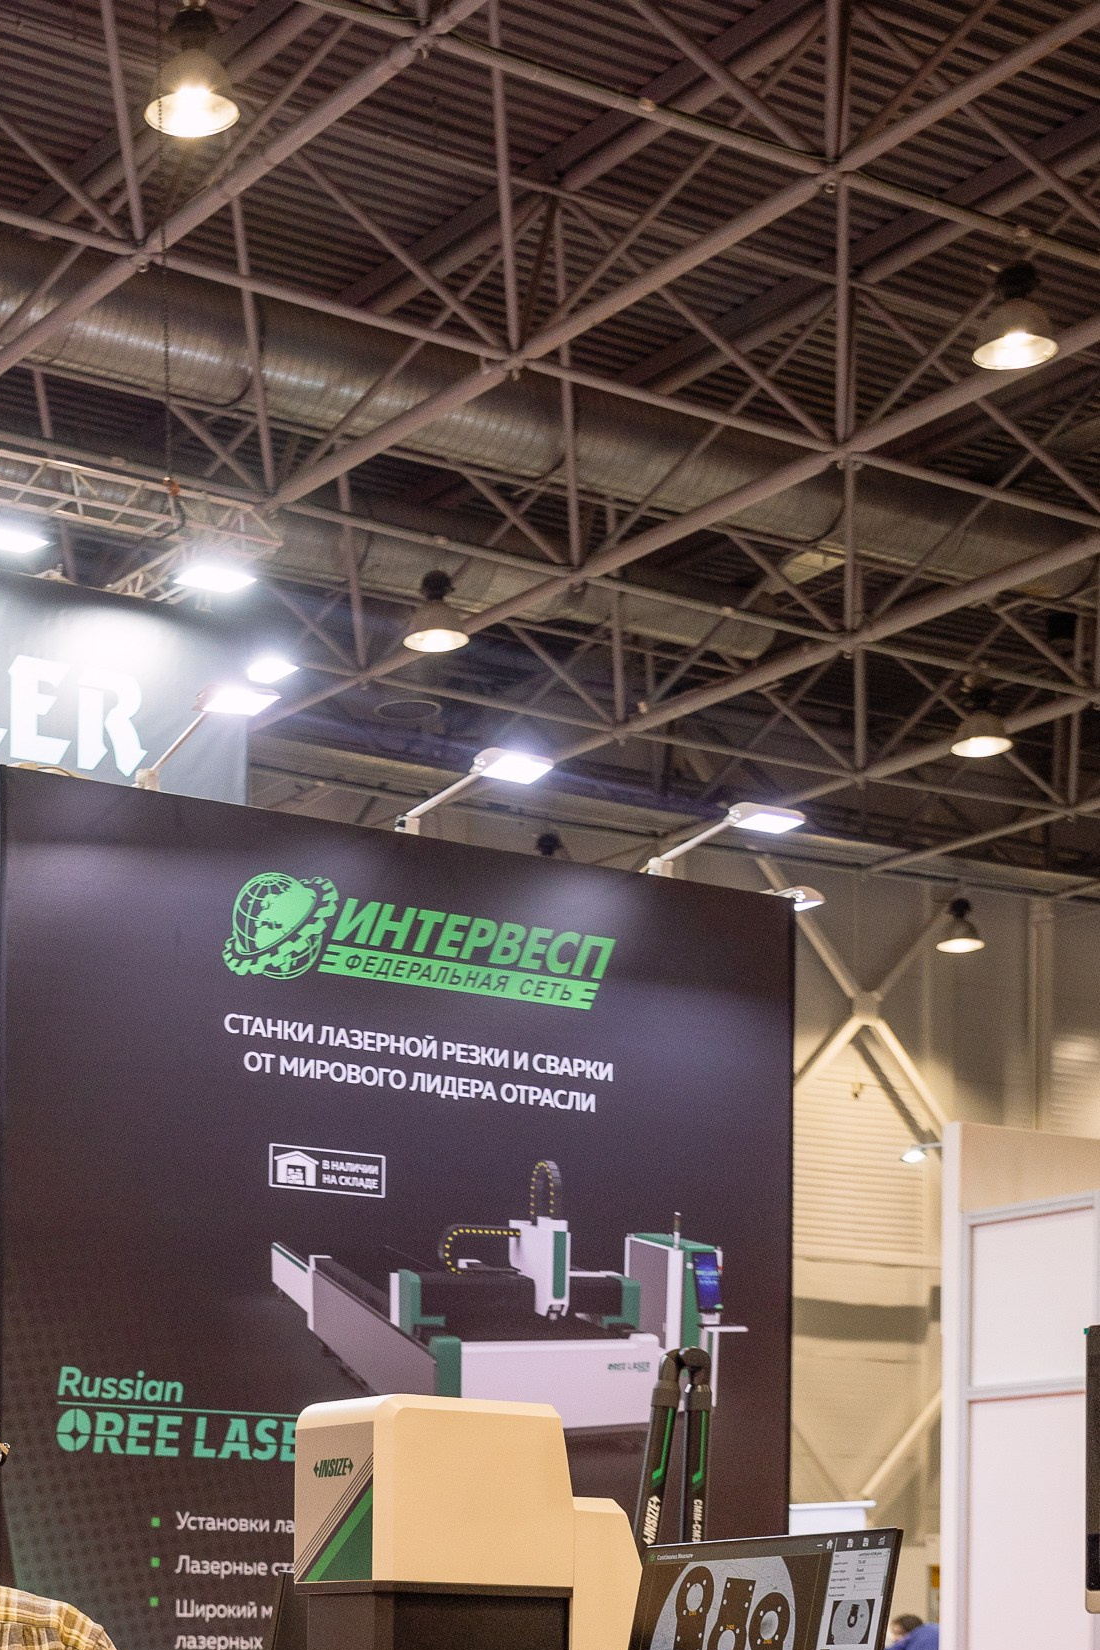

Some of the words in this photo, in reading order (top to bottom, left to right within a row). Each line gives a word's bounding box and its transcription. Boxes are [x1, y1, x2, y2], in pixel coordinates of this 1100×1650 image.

[331, 898, 616, 980] ИНТЕРВЕСП
[346, 953, 509, 993] ФЕДЕРАЛЬНАЯ
[519, 978, 572, 1002] СЕТЬ
[224, 1013, 314, 1045] СТАНКИ
[317, 1024, 438, 1060] ЛАЗЕРНОЙ
[442, 1041, 509, 1069] РЕЗКИ
[514, 1050, 529, 1072] И
[533, 1053, 615, 1082] СВАРКИ
[243, 1051, 275, 1074] ОТ
[279, 1056, 407, 1090] МИРОВОГО
[410, 1072, 497, 1101] ЛИДЕРА
[500, 1083, 596, 1113] ОТРАСЛИ
[322, 1160, 330, 1170] В
[331, 1161, 379, 1176] НАЛИЧИИ
[322, 1174, 338, 1185] НА
[338, 1175, 379, 1190] СКЛАДЕ
[57, 1366, 184, 1403] Russian
[319, 1457, 349, 1478] INSIZE
[175, 1511, 270, 1533] Установки
[643, 1500, 660, 1540] INSIZE
[174, 1555, 268, 1579] Лазерные
[175, 1598, 257, 1622] Широкий
